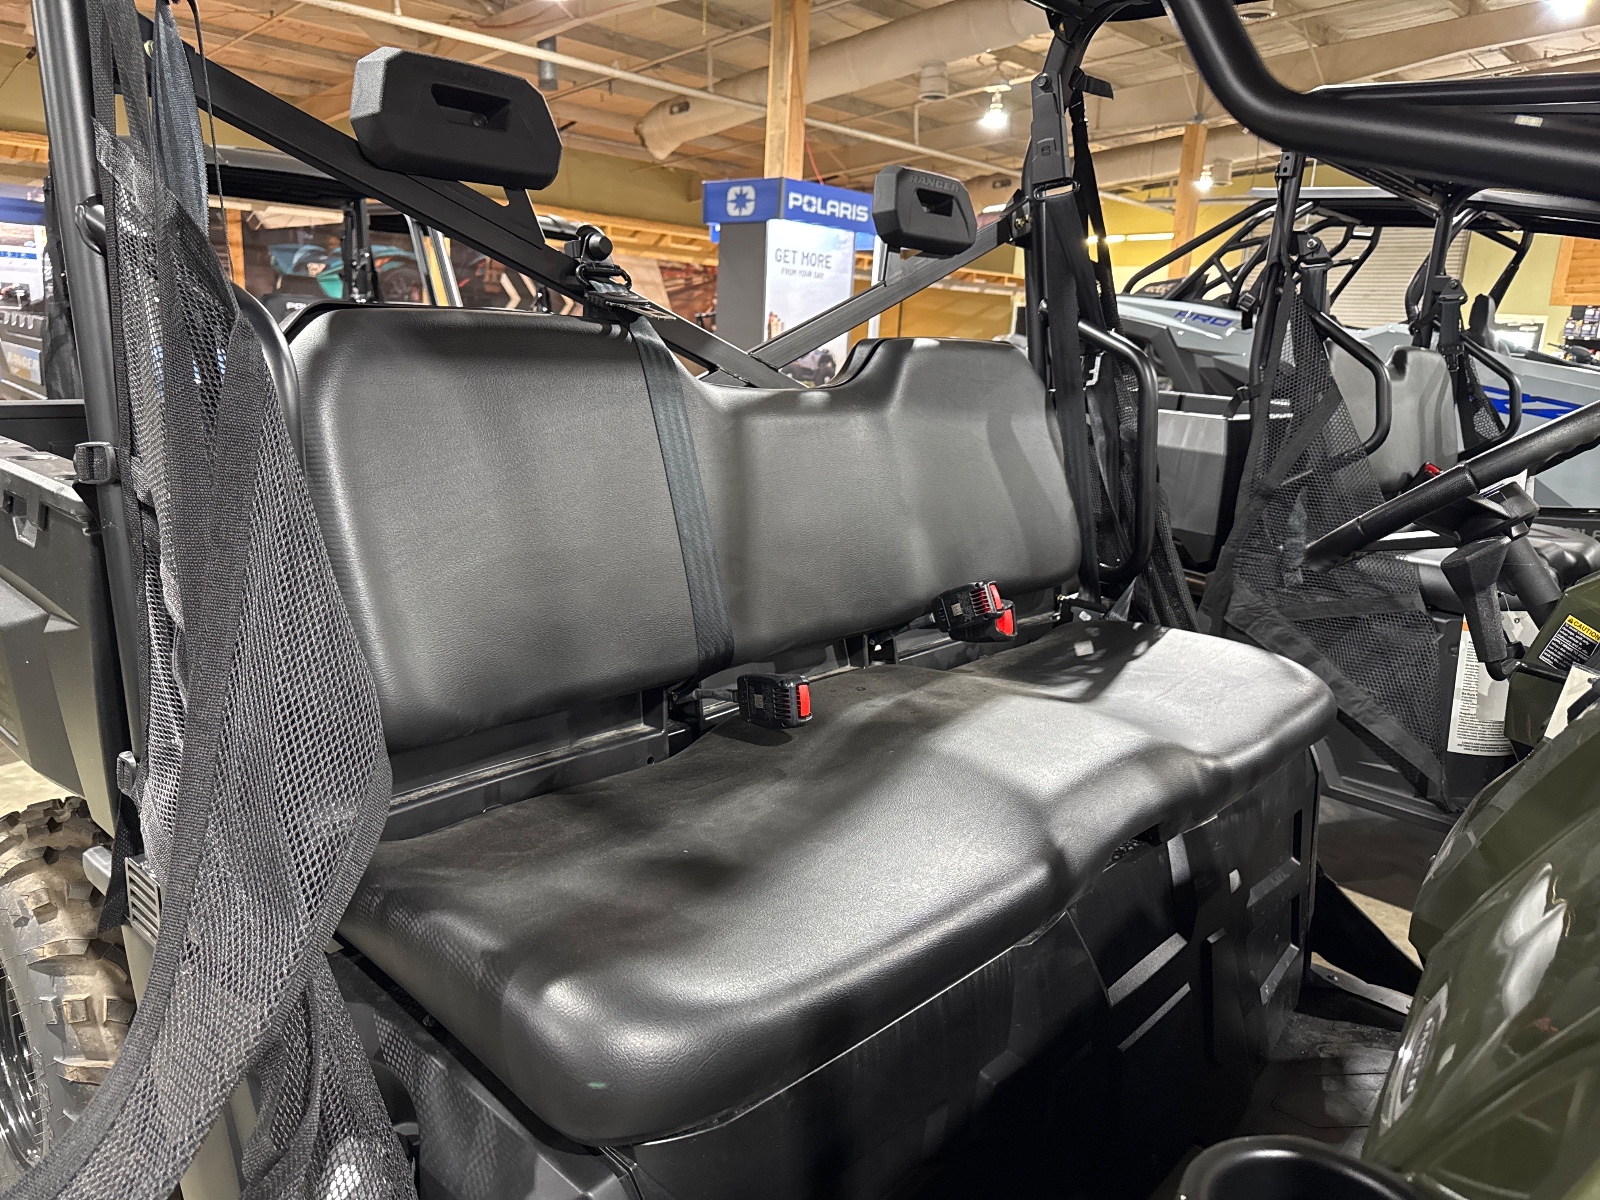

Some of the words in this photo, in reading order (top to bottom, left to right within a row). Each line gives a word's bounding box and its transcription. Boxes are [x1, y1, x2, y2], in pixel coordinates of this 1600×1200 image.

[908, 174, 960, 193] RANGER
[788, 191, 869, 222] POLARIS
[774, 248, 798, 265] GET
[800, 251, 833, 269] MORE
[1174, 310, 1233, 327] PRO
